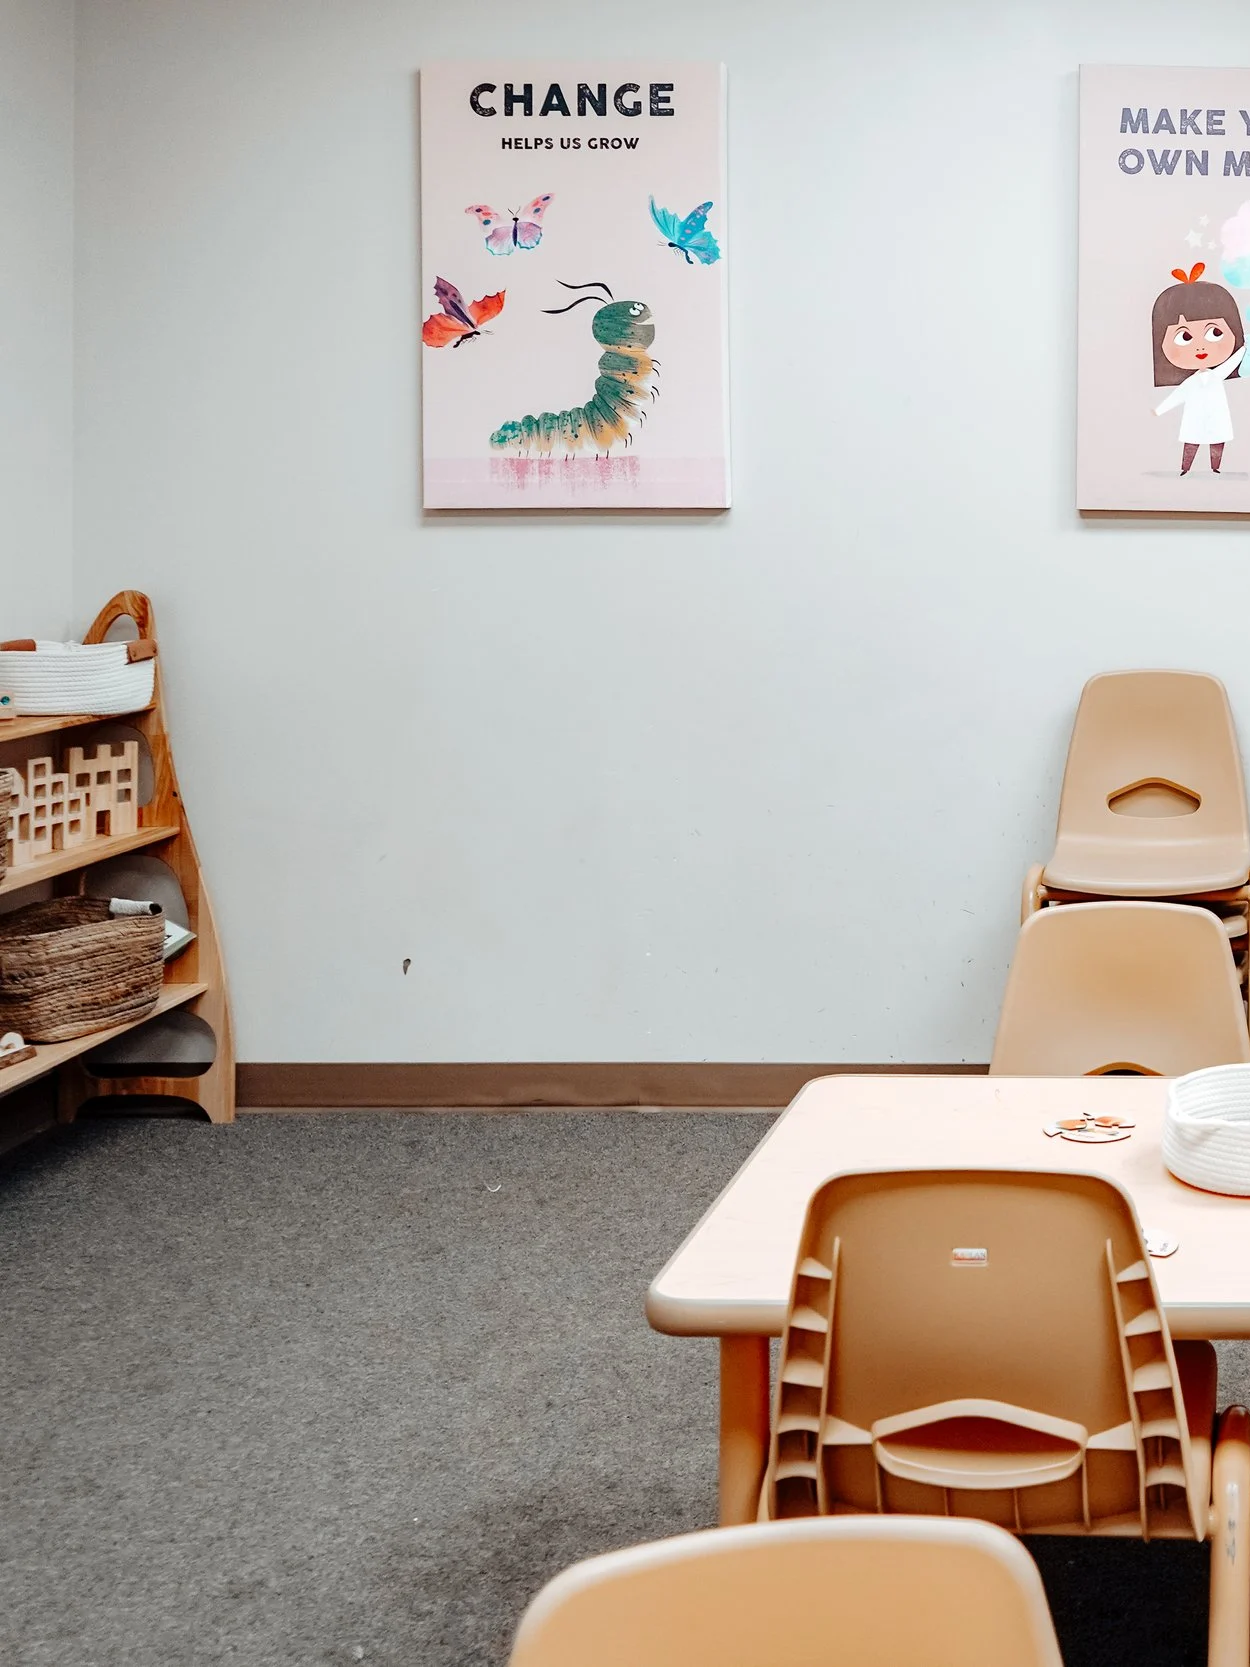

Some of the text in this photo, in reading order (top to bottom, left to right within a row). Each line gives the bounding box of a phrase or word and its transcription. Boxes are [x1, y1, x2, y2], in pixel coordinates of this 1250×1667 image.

[469, 82, 675, 118] CHANGE
[1119, 107, 1226, 136] MAKE
[501, 137, 640, 150] HELPS US GROW
[1117, 148, 1209, 176] OWN
